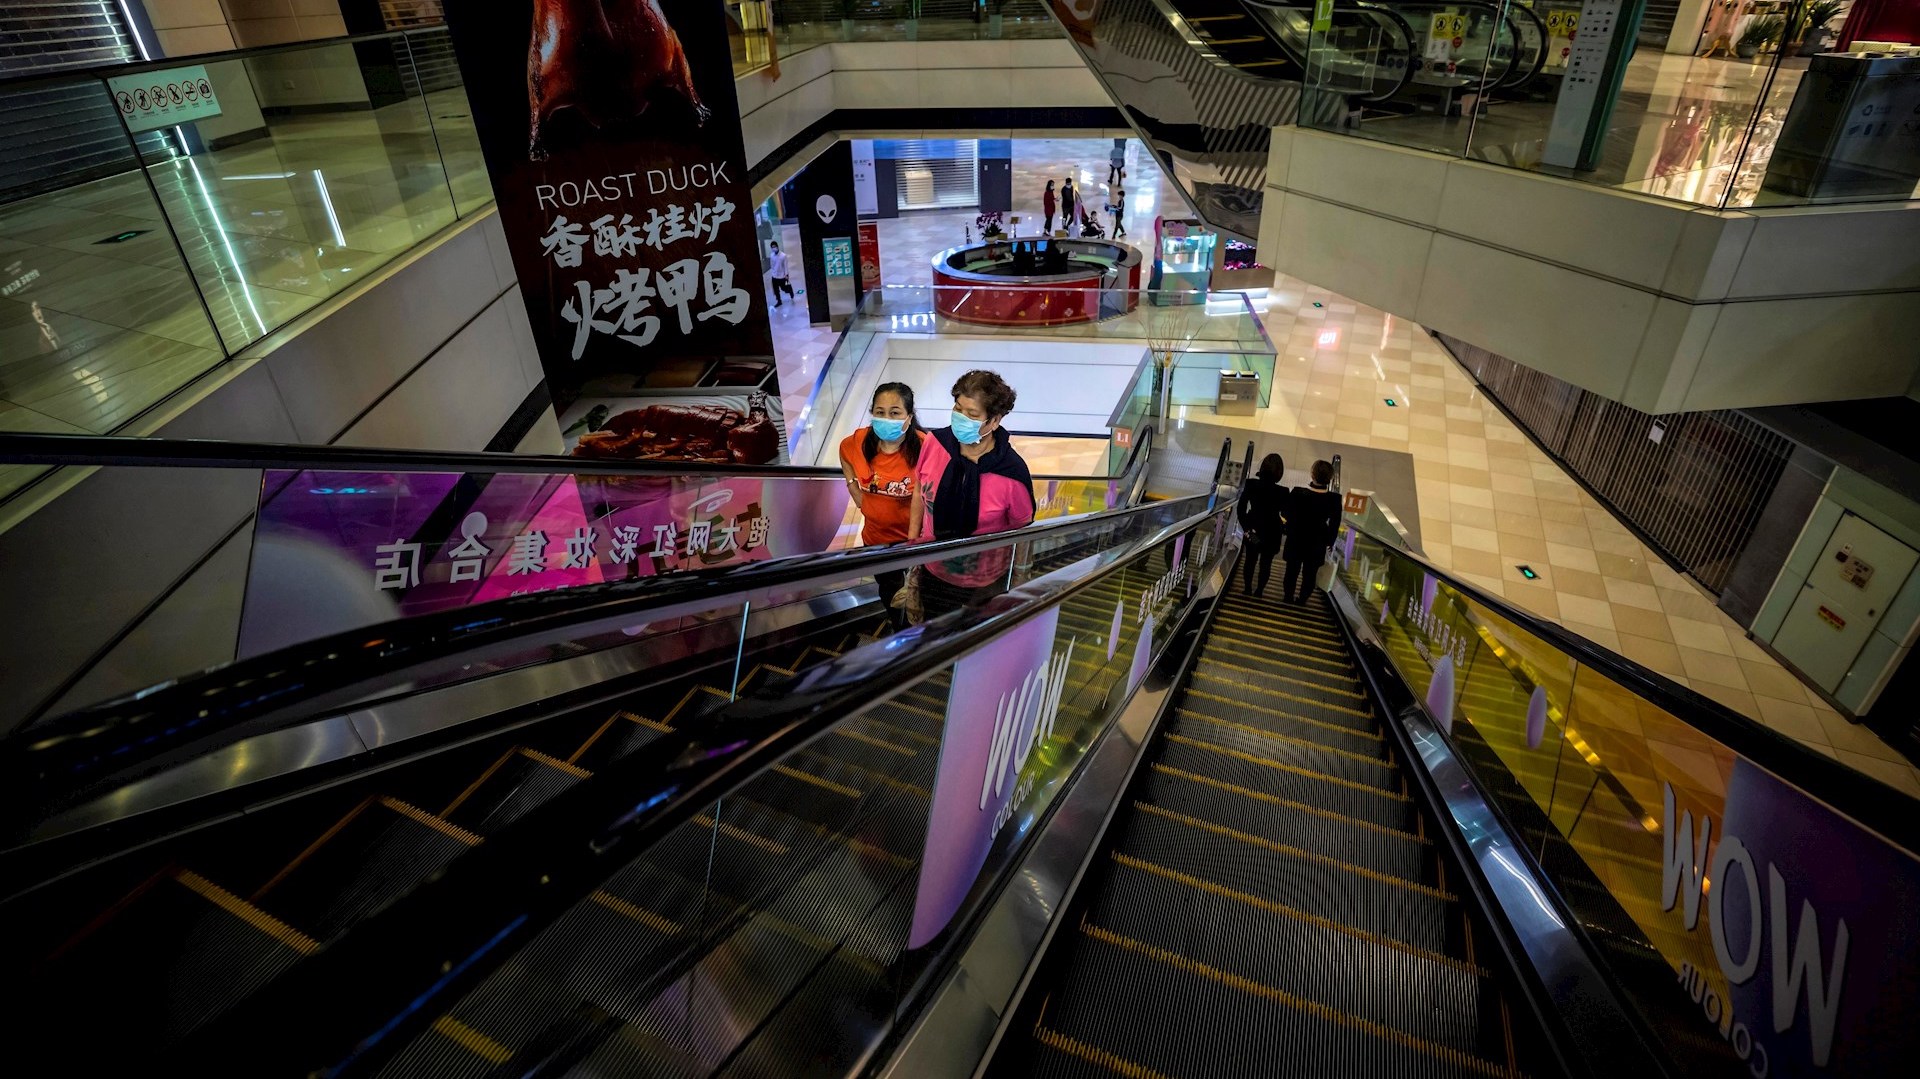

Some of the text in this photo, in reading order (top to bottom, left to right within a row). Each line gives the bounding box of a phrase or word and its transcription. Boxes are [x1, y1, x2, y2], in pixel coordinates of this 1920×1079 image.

[535, 161, 731, 210] ROAST DUCK
[560, 252, 751, 361] 烤鸭
[1347, 496, 1364, 510] L1
[979, 635, 1076, 812] WOW
[991, 771, 1036, 840] COLOUR
